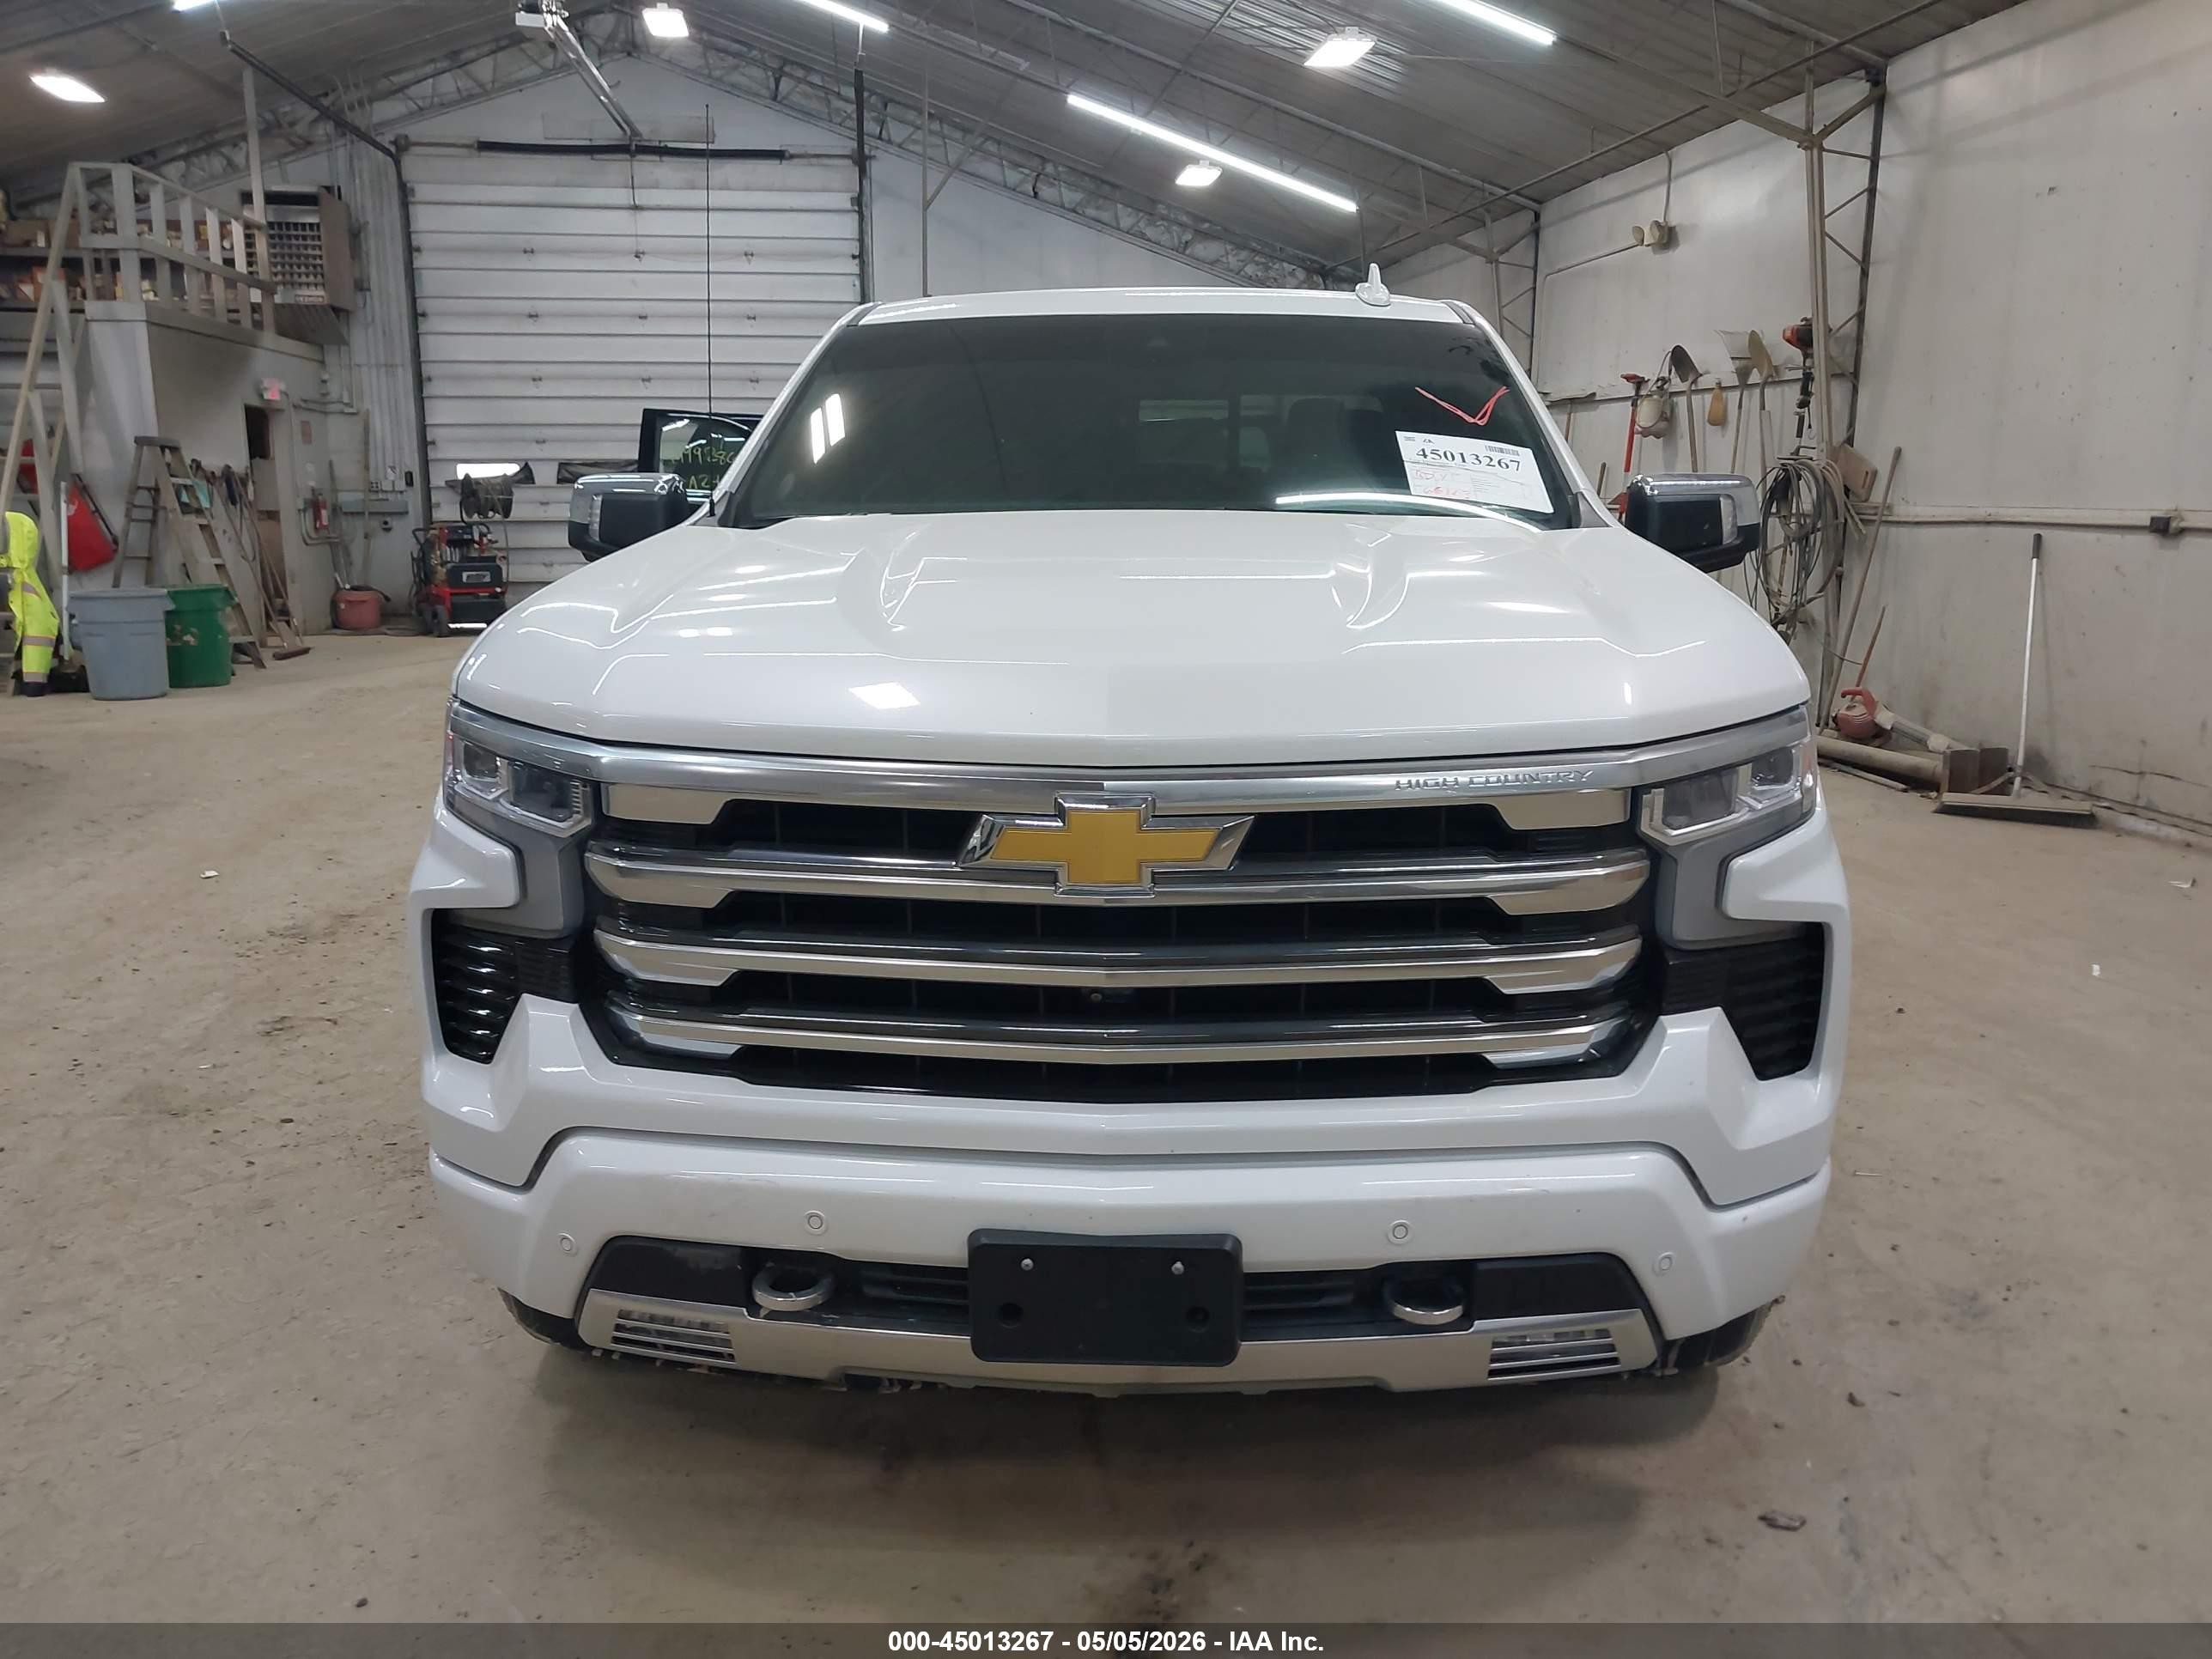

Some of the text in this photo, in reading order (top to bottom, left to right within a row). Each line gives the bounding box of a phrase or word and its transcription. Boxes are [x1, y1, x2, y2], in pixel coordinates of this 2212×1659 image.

[1416, 447, 1521, 471] 45013267
[1395, 770, 1594, 790] HIGH COUNTRY
